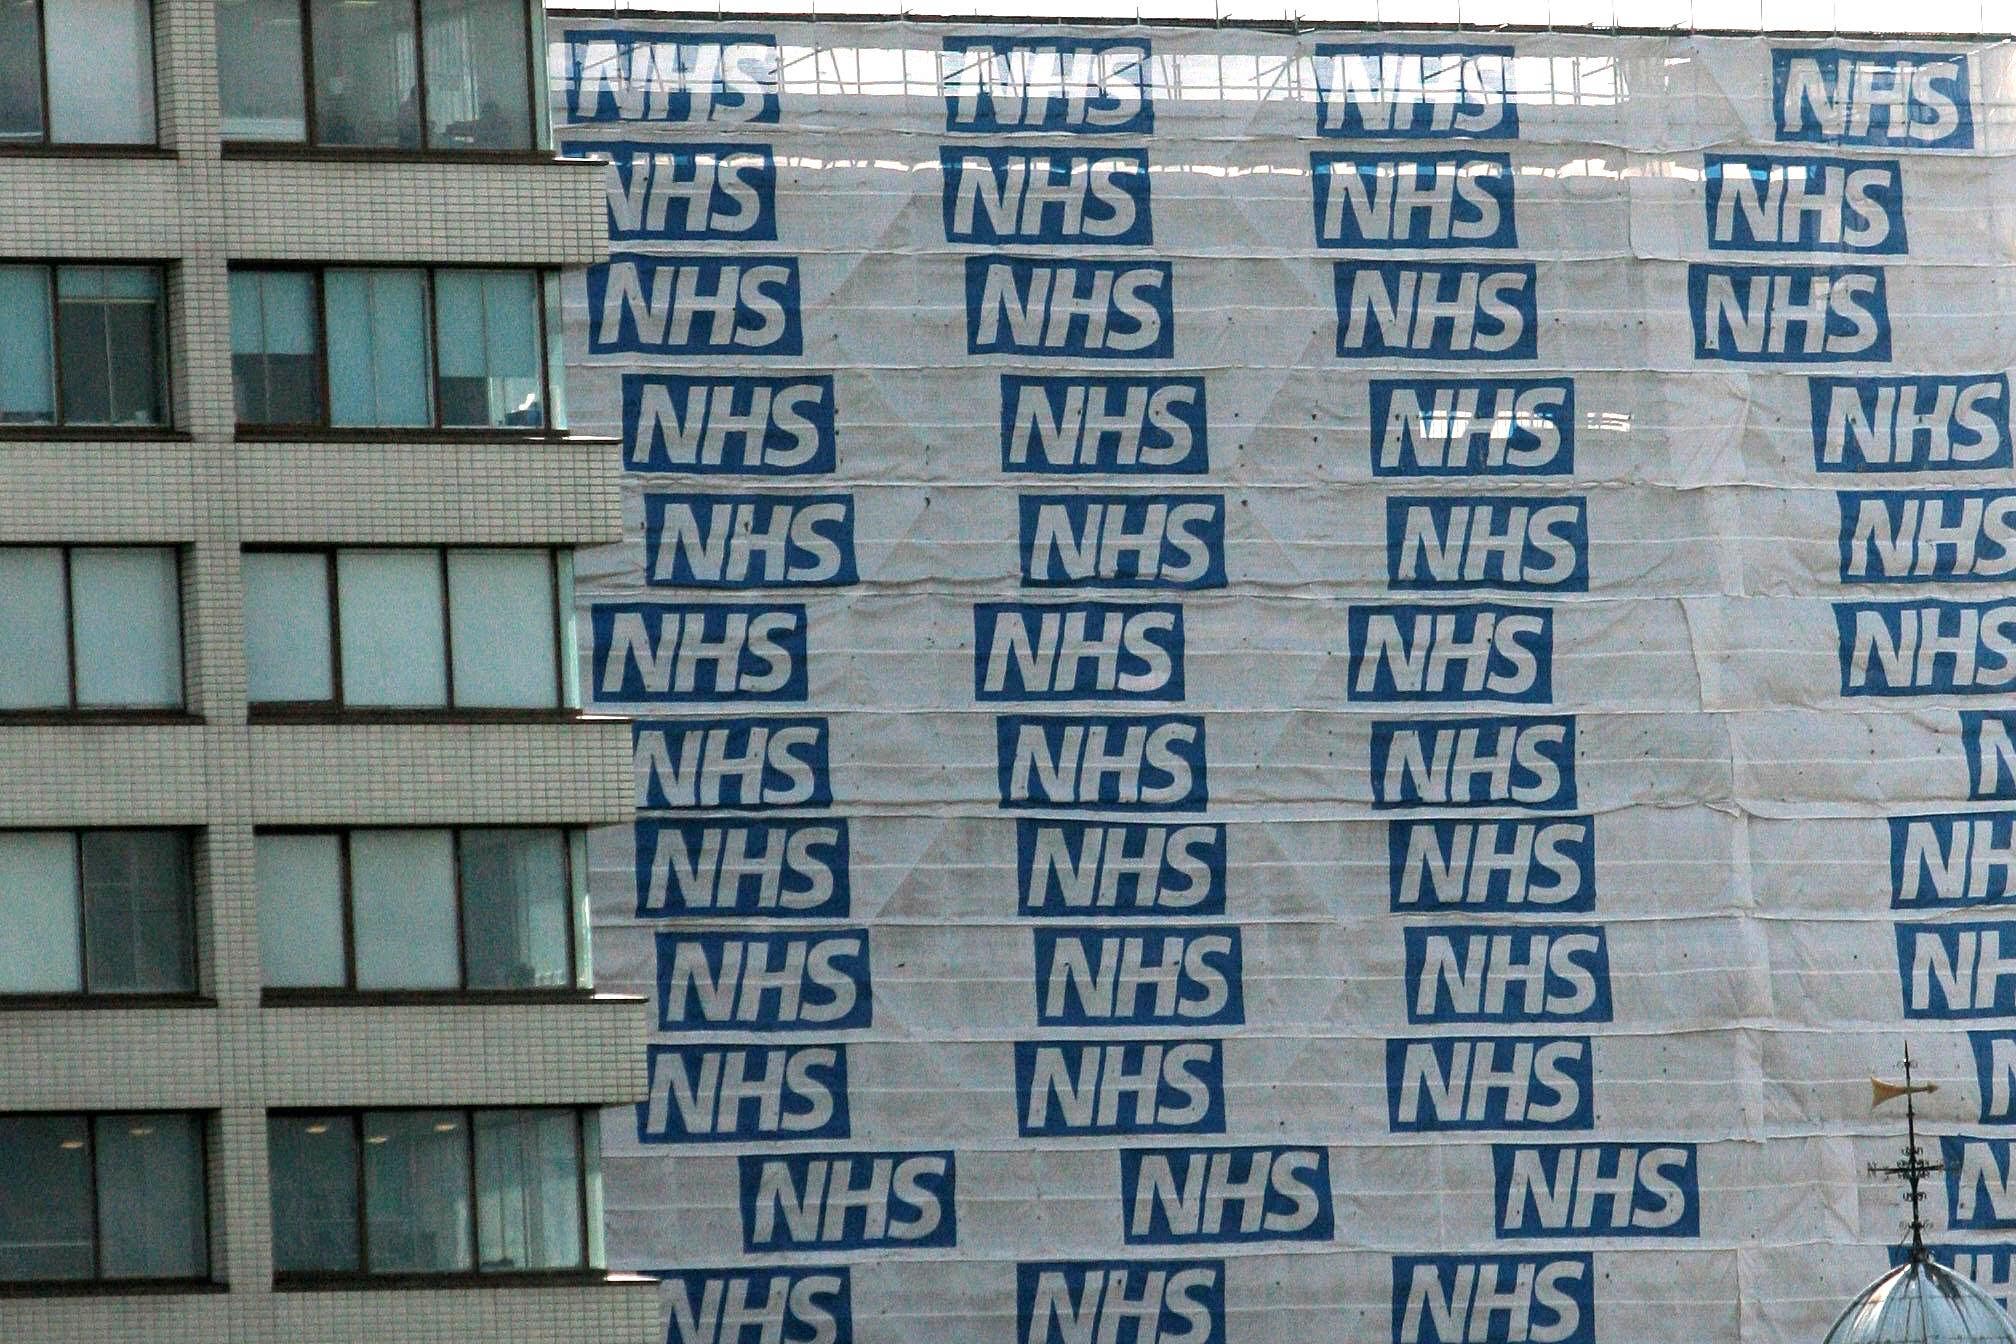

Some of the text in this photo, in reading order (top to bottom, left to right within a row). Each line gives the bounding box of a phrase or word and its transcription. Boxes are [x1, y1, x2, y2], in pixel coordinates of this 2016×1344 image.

[577, 42, 776, 121] NHS
[957, 45, 1144, 126] NHS
[1325, 53, 1507, 132] NHS
[1783, 56, 1962, 142] NHS
[595, 153, 764, 232] NHS
[953, 156, 1137, 236] NHS
[1323, 162, 1503, 241] NHS
[1715, 164, 1893, 246] NHS
[598, 262, 789, 347] NHS
[976, 265, 1162, 350] NHS
[1345, 270, 1527, 352] NHS
[1705, 274, 1879, 353] NHS
[632, 384, 823, 466] NHS
[1009, 384, 1196, 466] NHS
[1379, 388, 1566, 467] NHS
[1824, 383, 2002, 464] NHS
[655, 503, 846, 582] NHS
[1031, 504, 1215, 582] NHS
[1400, 506, 1577, 583] NHS
[1848, 496, 2016, 577] NHS
[603, 612, 797, 692] NHS
[984, 611, 1175, 692] NHS
[1357, 614, 1542, 694] NHS
[1850, 606, 2016, 687] NHS
[634, 726, 820, 807] NHS
[1011, 725, 1196, 803] NHS
[1384, 725, 1565, 803] NHS
[647, 826, 838, 910] NHS
[1029, 826, 1216, 908] NHS
[1400, 823, 1582, 904] NHS
[666, 938, 860, 1023] NHS
[1046, 935, 1231, 1018] NHS
[1416, 934, 1599, 1016] NHS
[647, 1047, 835, 1134] NHS
[1028, 1044, 1213, 1127] NHS
[1398, 1040, 1582, 1123] NHS
[752, 1157, 946, 1242] NHS
[1132, 1151, 1320, 1235] NHS
[1503, 1147, 1688, 1229] NHS
[662, 1275, 841, 1344] NHS
[1028, 1268, 1216, 1344] NHS
[1401, 1260, 1583, 1344] NHS
